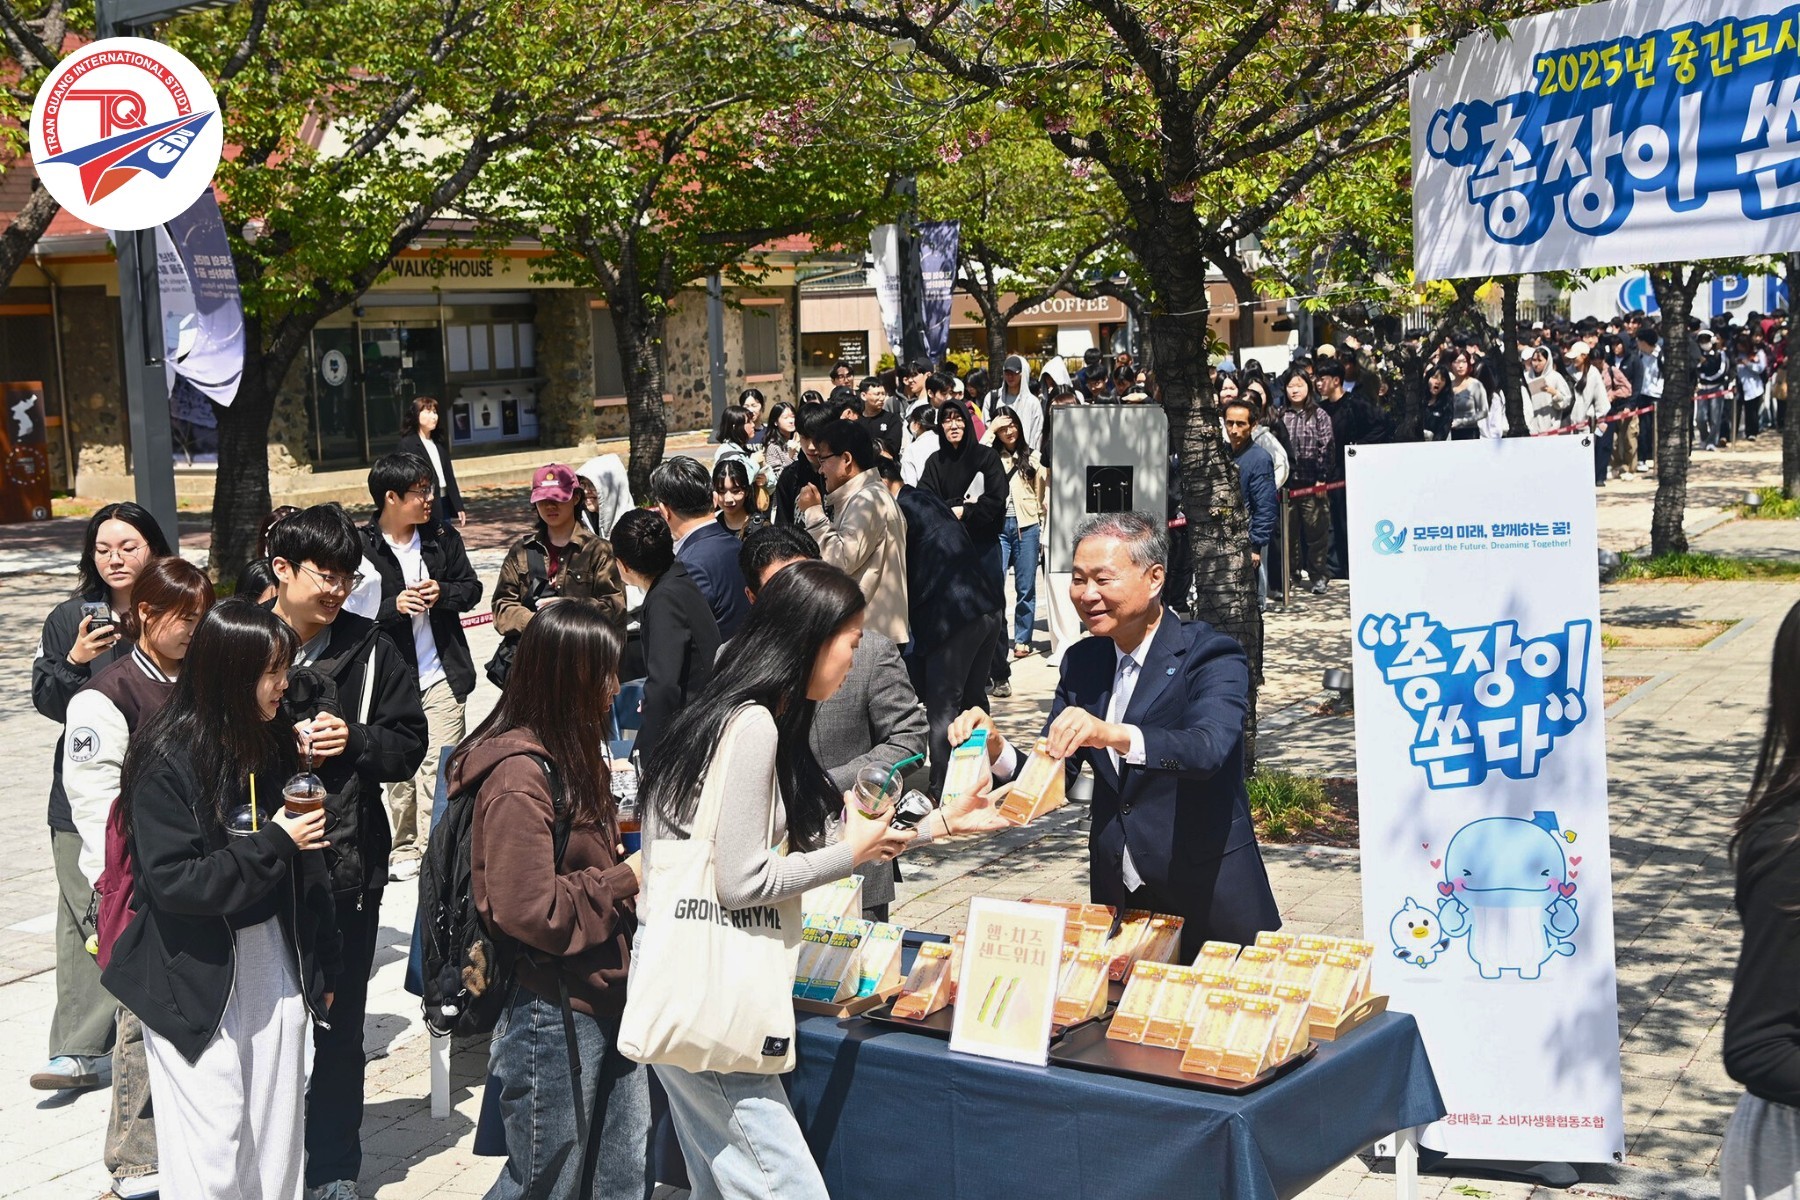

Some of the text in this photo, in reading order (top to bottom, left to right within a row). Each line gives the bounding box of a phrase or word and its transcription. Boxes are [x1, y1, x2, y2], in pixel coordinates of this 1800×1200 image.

[1536, 37, 1655, 97] 2025년
[391, 260, 493, 278] WALKER HOUSE
[1413, 521, 1572, 541] 모두의 미래, 함께하는 꿈!
[1413, 543, 1442, 552] Toward
[1445, 542, 1458, 551] the
[1491, 540, 1530, 551] Dreaming
[1532, 538, 1572, 549] Together!
[1440, 1112, 1605, 1129] 경대학교 소비자생활협동조합
